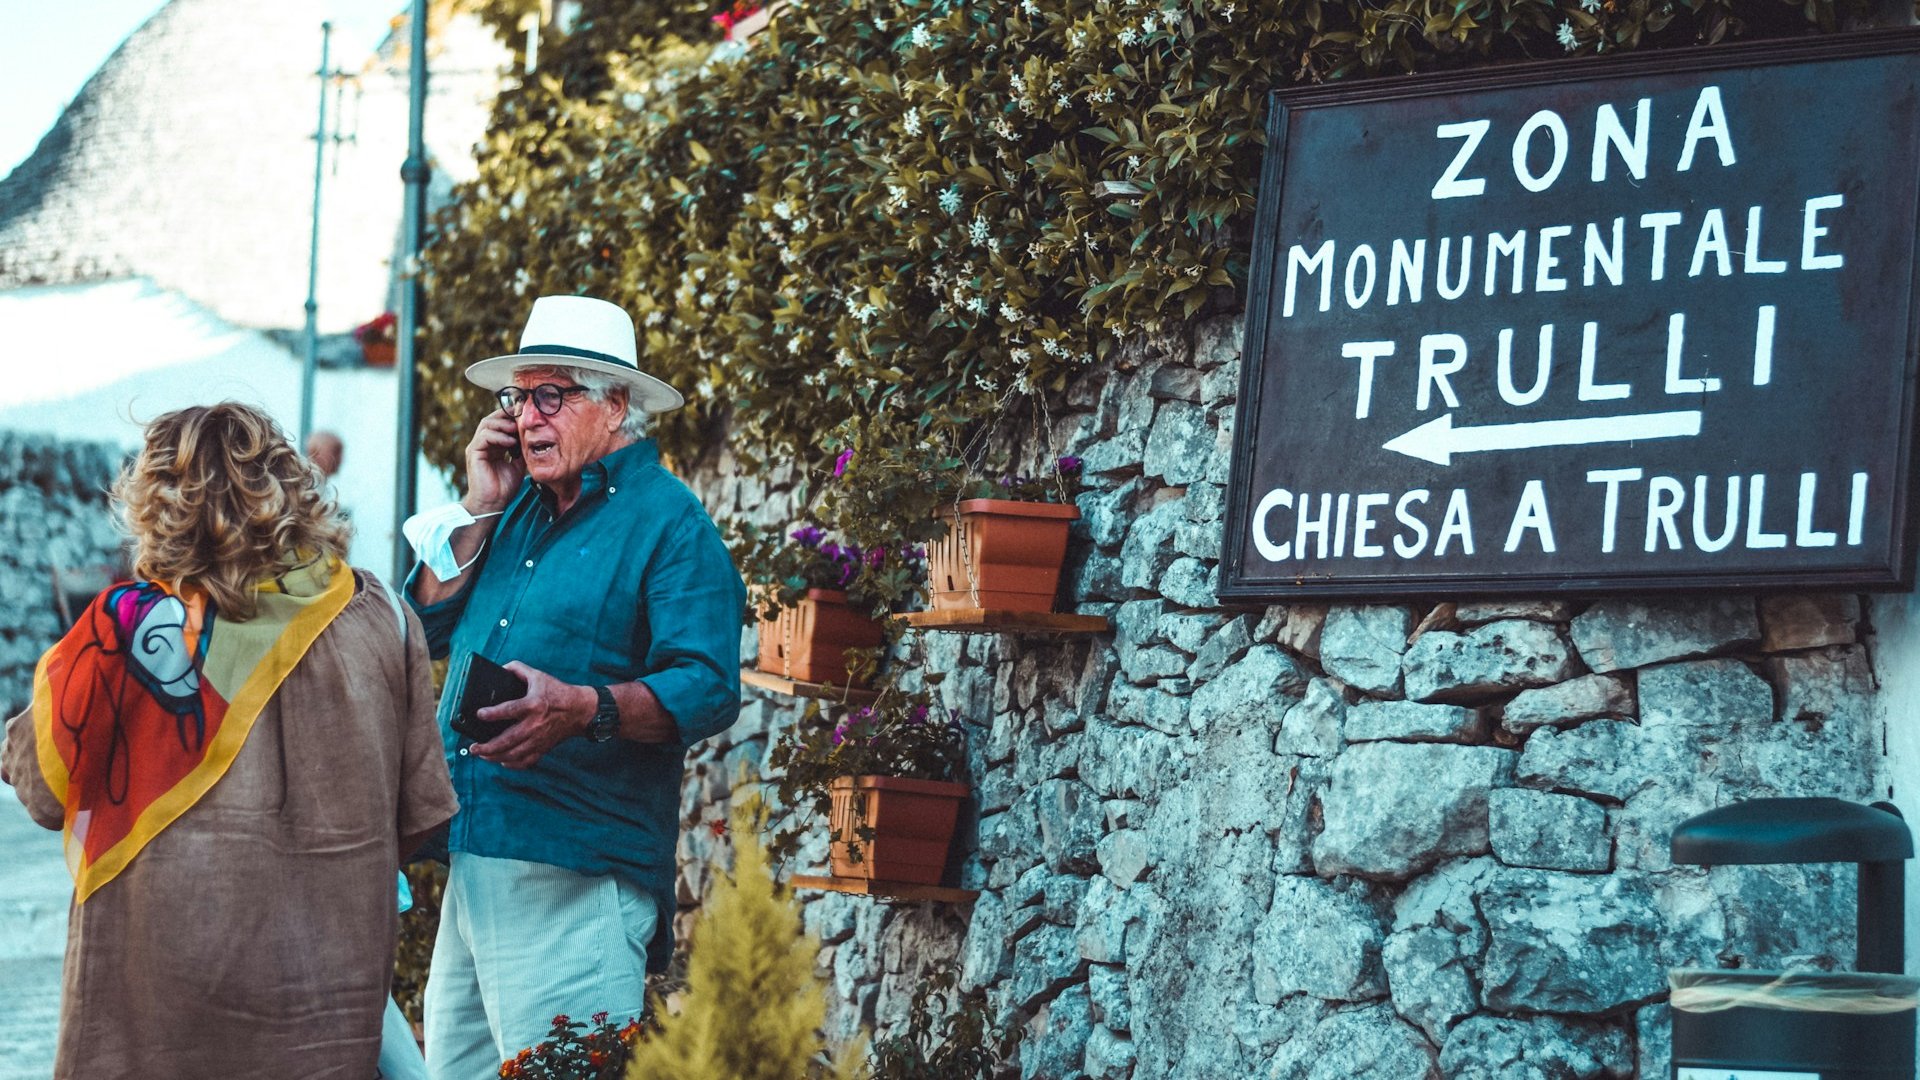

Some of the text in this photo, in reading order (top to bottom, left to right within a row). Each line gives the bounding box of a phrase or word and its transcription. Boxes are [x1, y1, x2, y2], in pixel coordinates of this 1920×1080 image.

[1430, 85, 1738, 200] ZONA
[1282, 193, 1845, 318] MONUMENTALE
[1341, 304, 1777, 420] TRULLI
[1252, 467, 1869, 562] CHIESA A TRULLI
